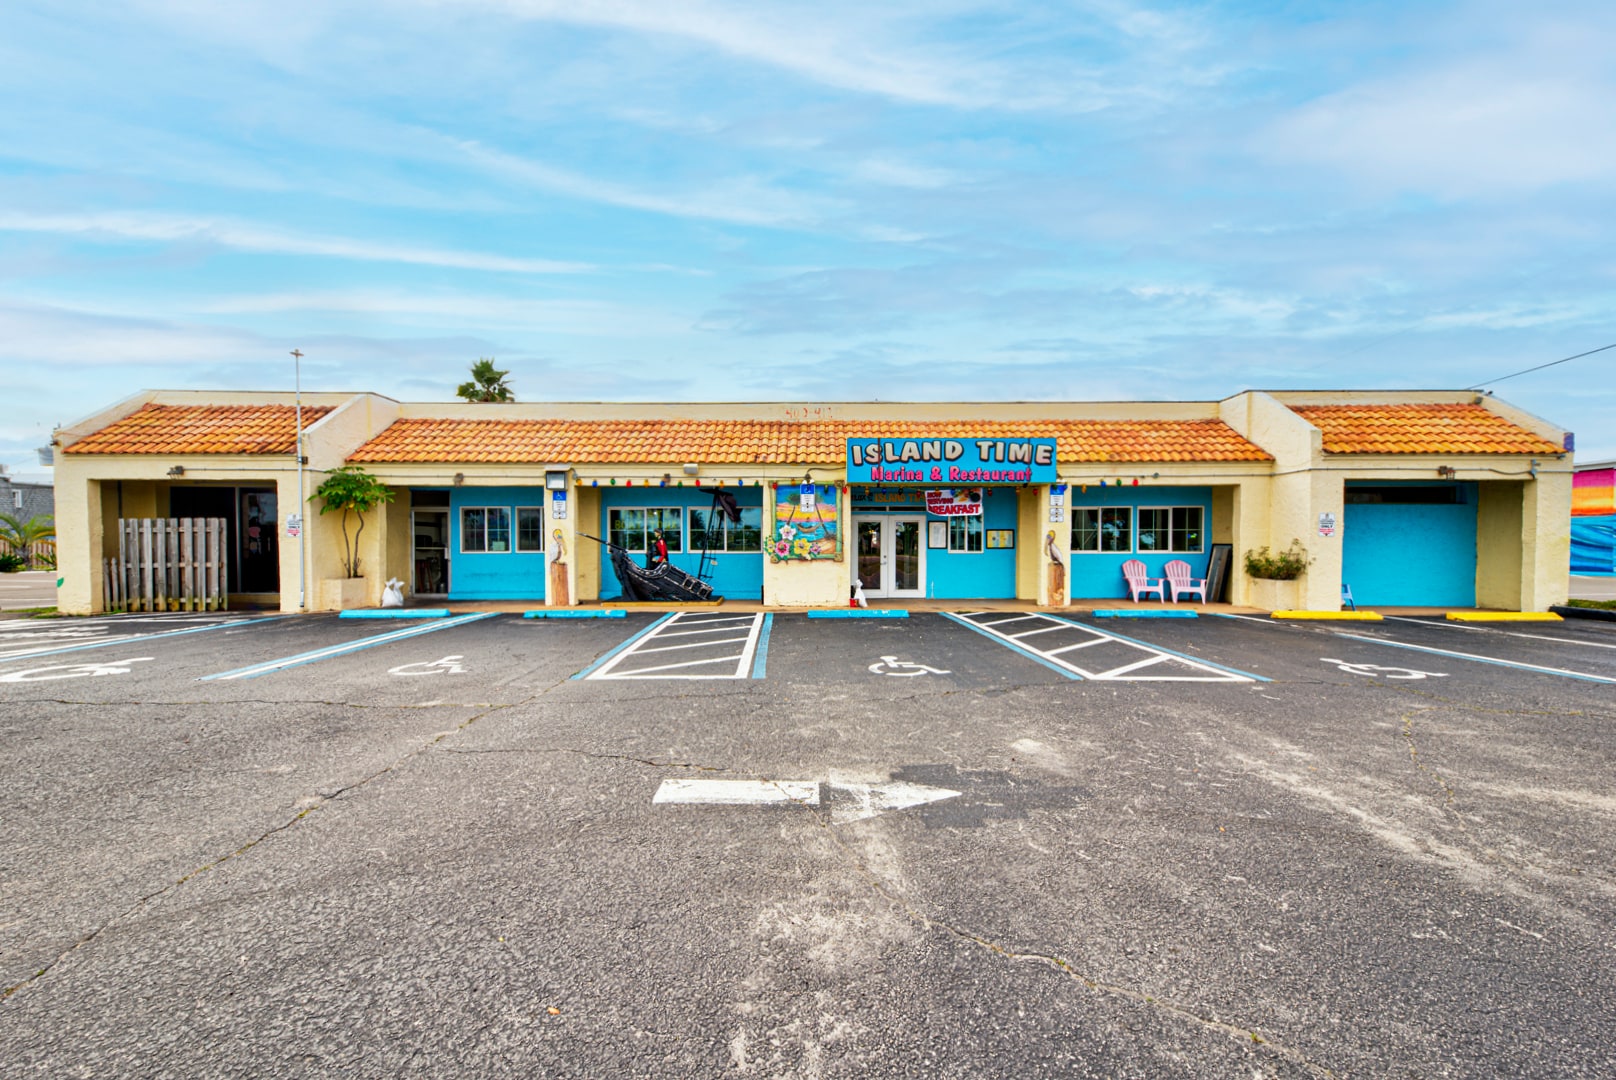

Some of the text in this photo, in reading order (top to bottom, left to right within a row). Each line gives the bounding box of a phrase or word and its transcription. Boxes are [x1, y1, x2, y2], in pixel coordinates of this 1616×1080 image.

[852, 440, 1053, 466] ISLAND TIME
[871, 465, 1032, 481] Marina & Restaurant
[927, 503, 981, 515] BREAKFAST
